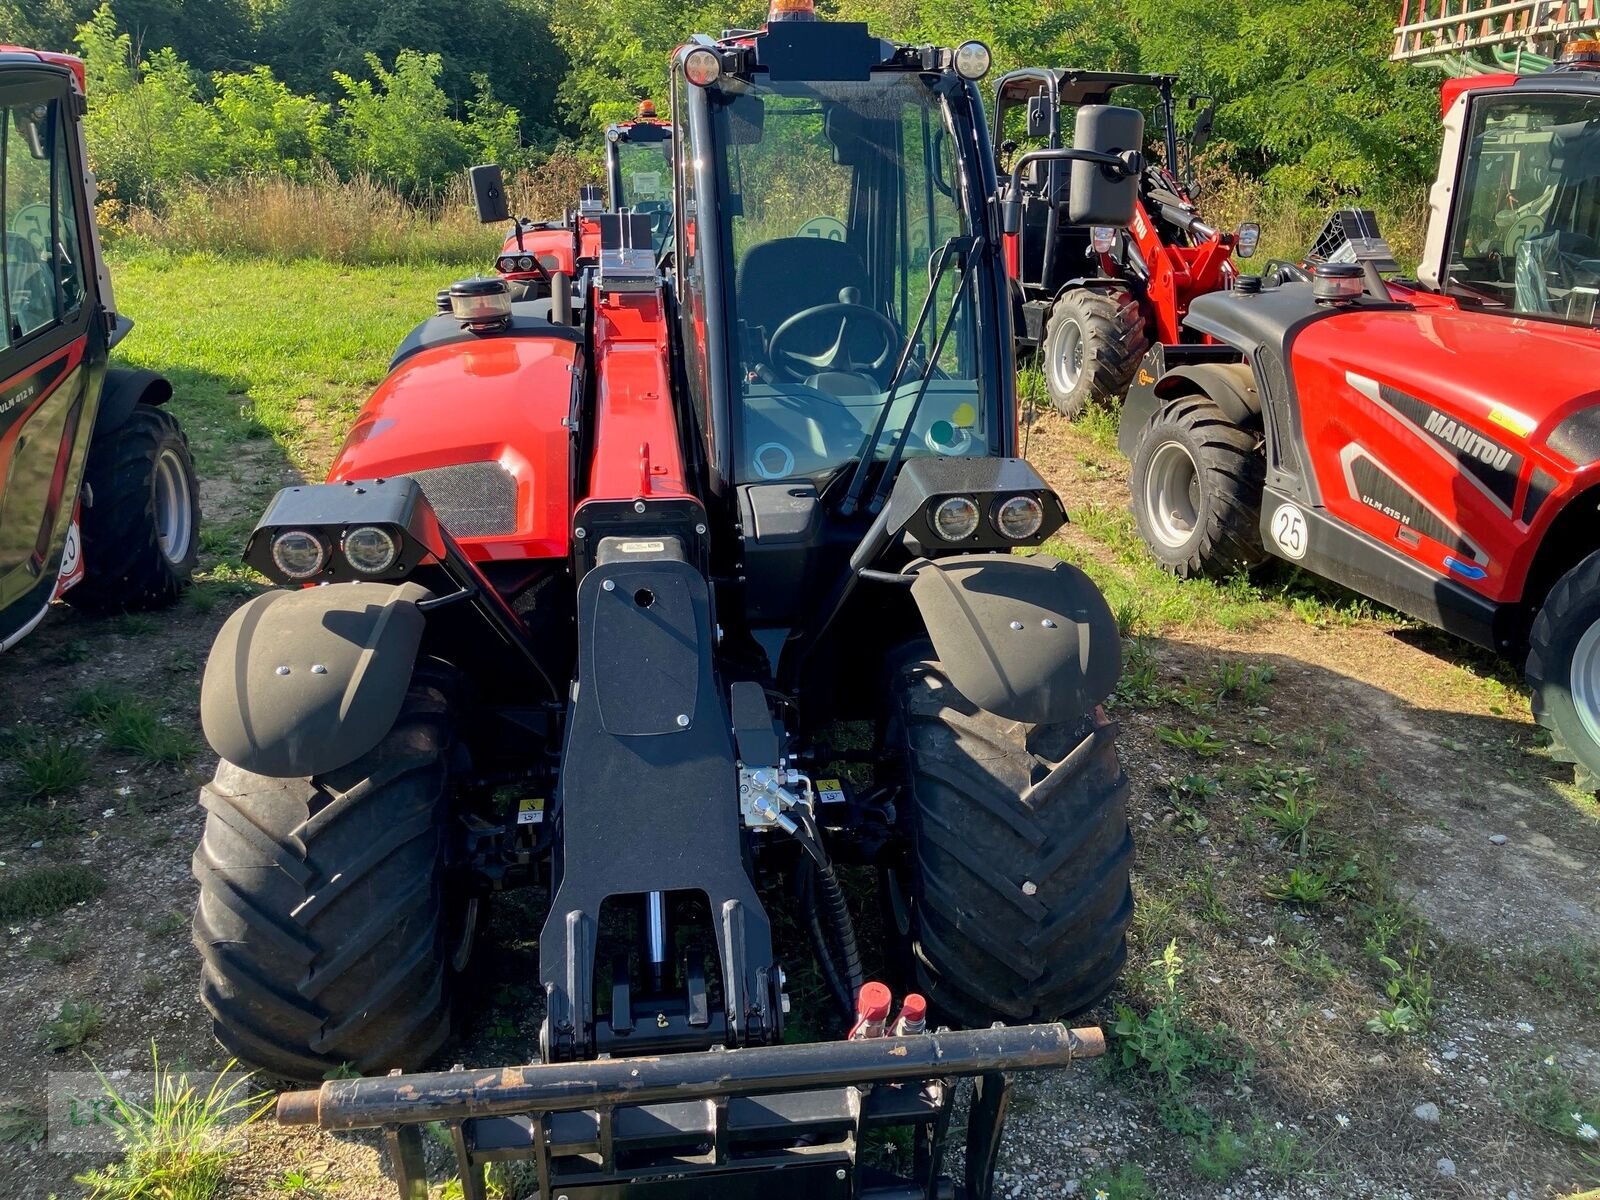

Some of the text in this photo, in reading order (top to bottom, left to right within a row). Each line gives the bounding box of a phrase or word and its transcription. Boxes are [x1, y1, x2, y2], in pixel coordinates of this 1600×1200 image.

[1424, 410, 1513, 472] MANITOU
[1362, 494, 1411, 525] ULM 415 H
[1278, 513, 1301, 551] 25
